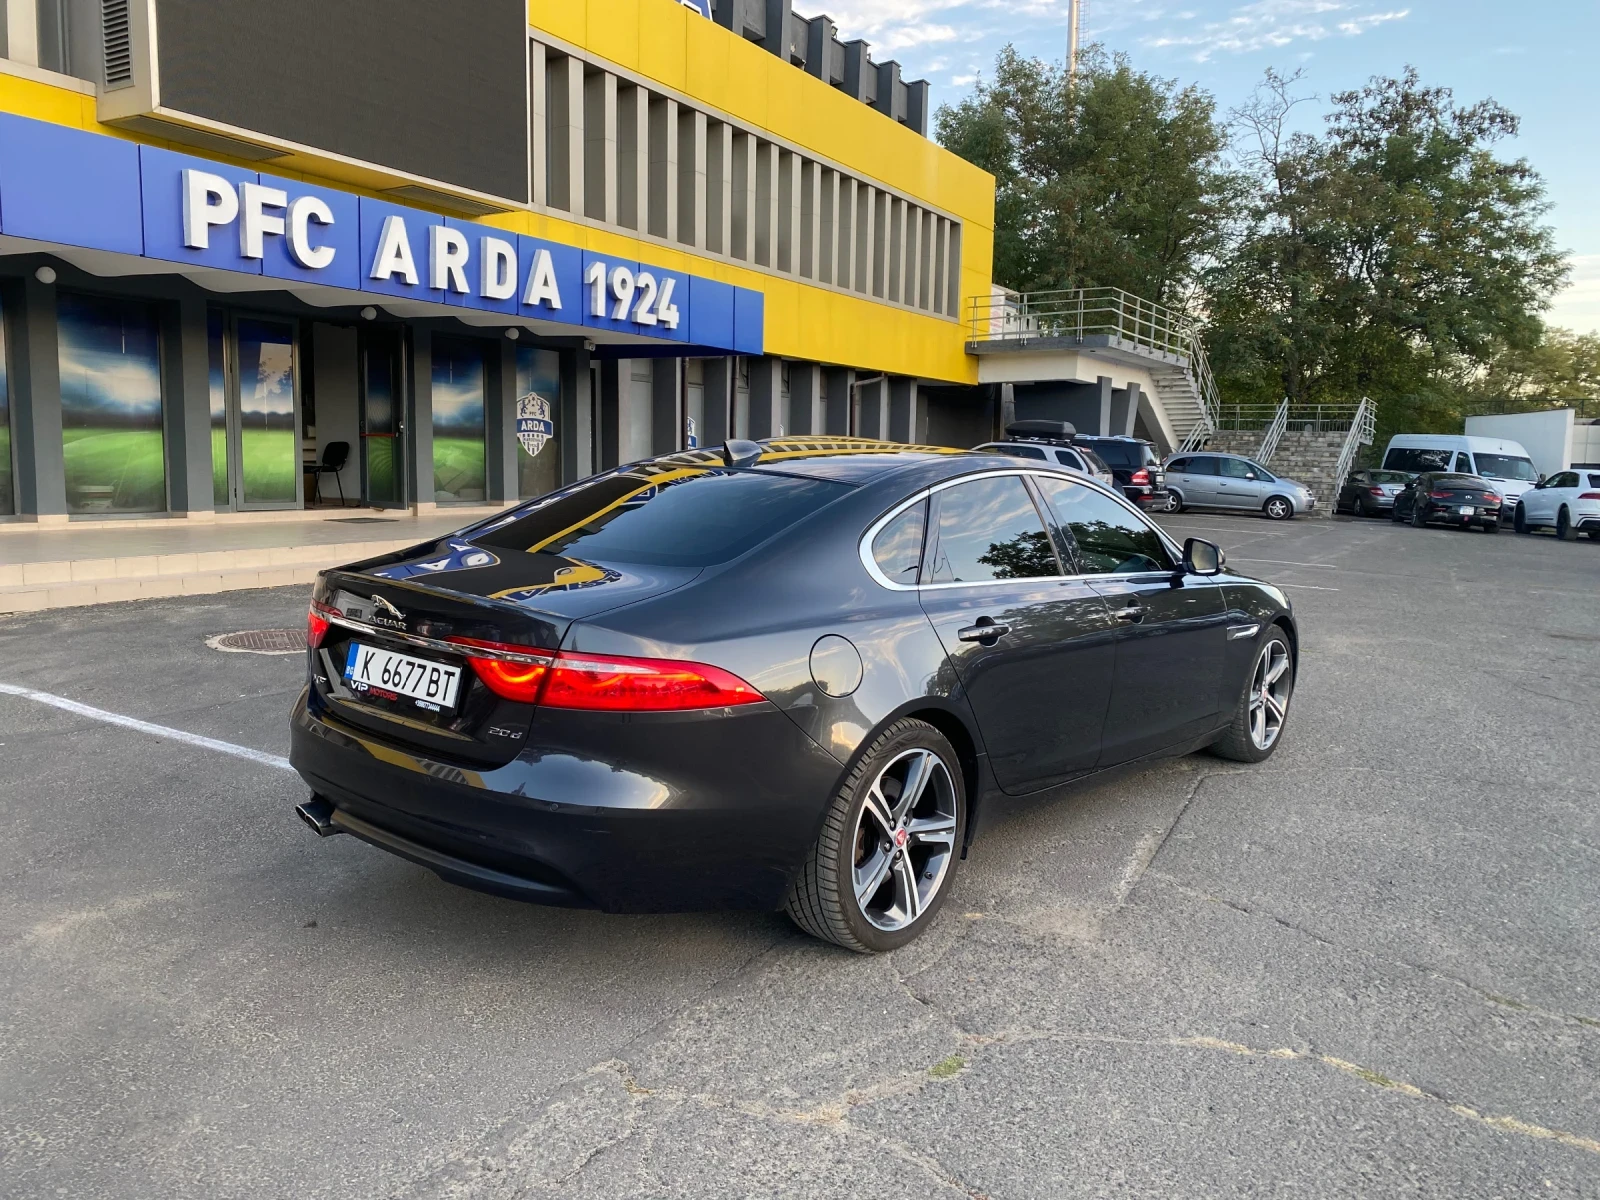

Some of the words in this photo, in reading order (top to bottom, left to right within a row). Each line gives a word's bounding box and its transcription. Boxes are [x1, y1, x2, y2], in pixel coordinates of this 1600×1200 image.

[181, 168, 337, 270] PFC
[369, 214, 563, 311] ARDA
[584, 261, 680, 331] 1924
[521, 420, 545, 431] ARDA
[361, 651, 375, 681] K
[350, 680, 369, 692] VIP
[368, 686, 398, 701] MOTORS
